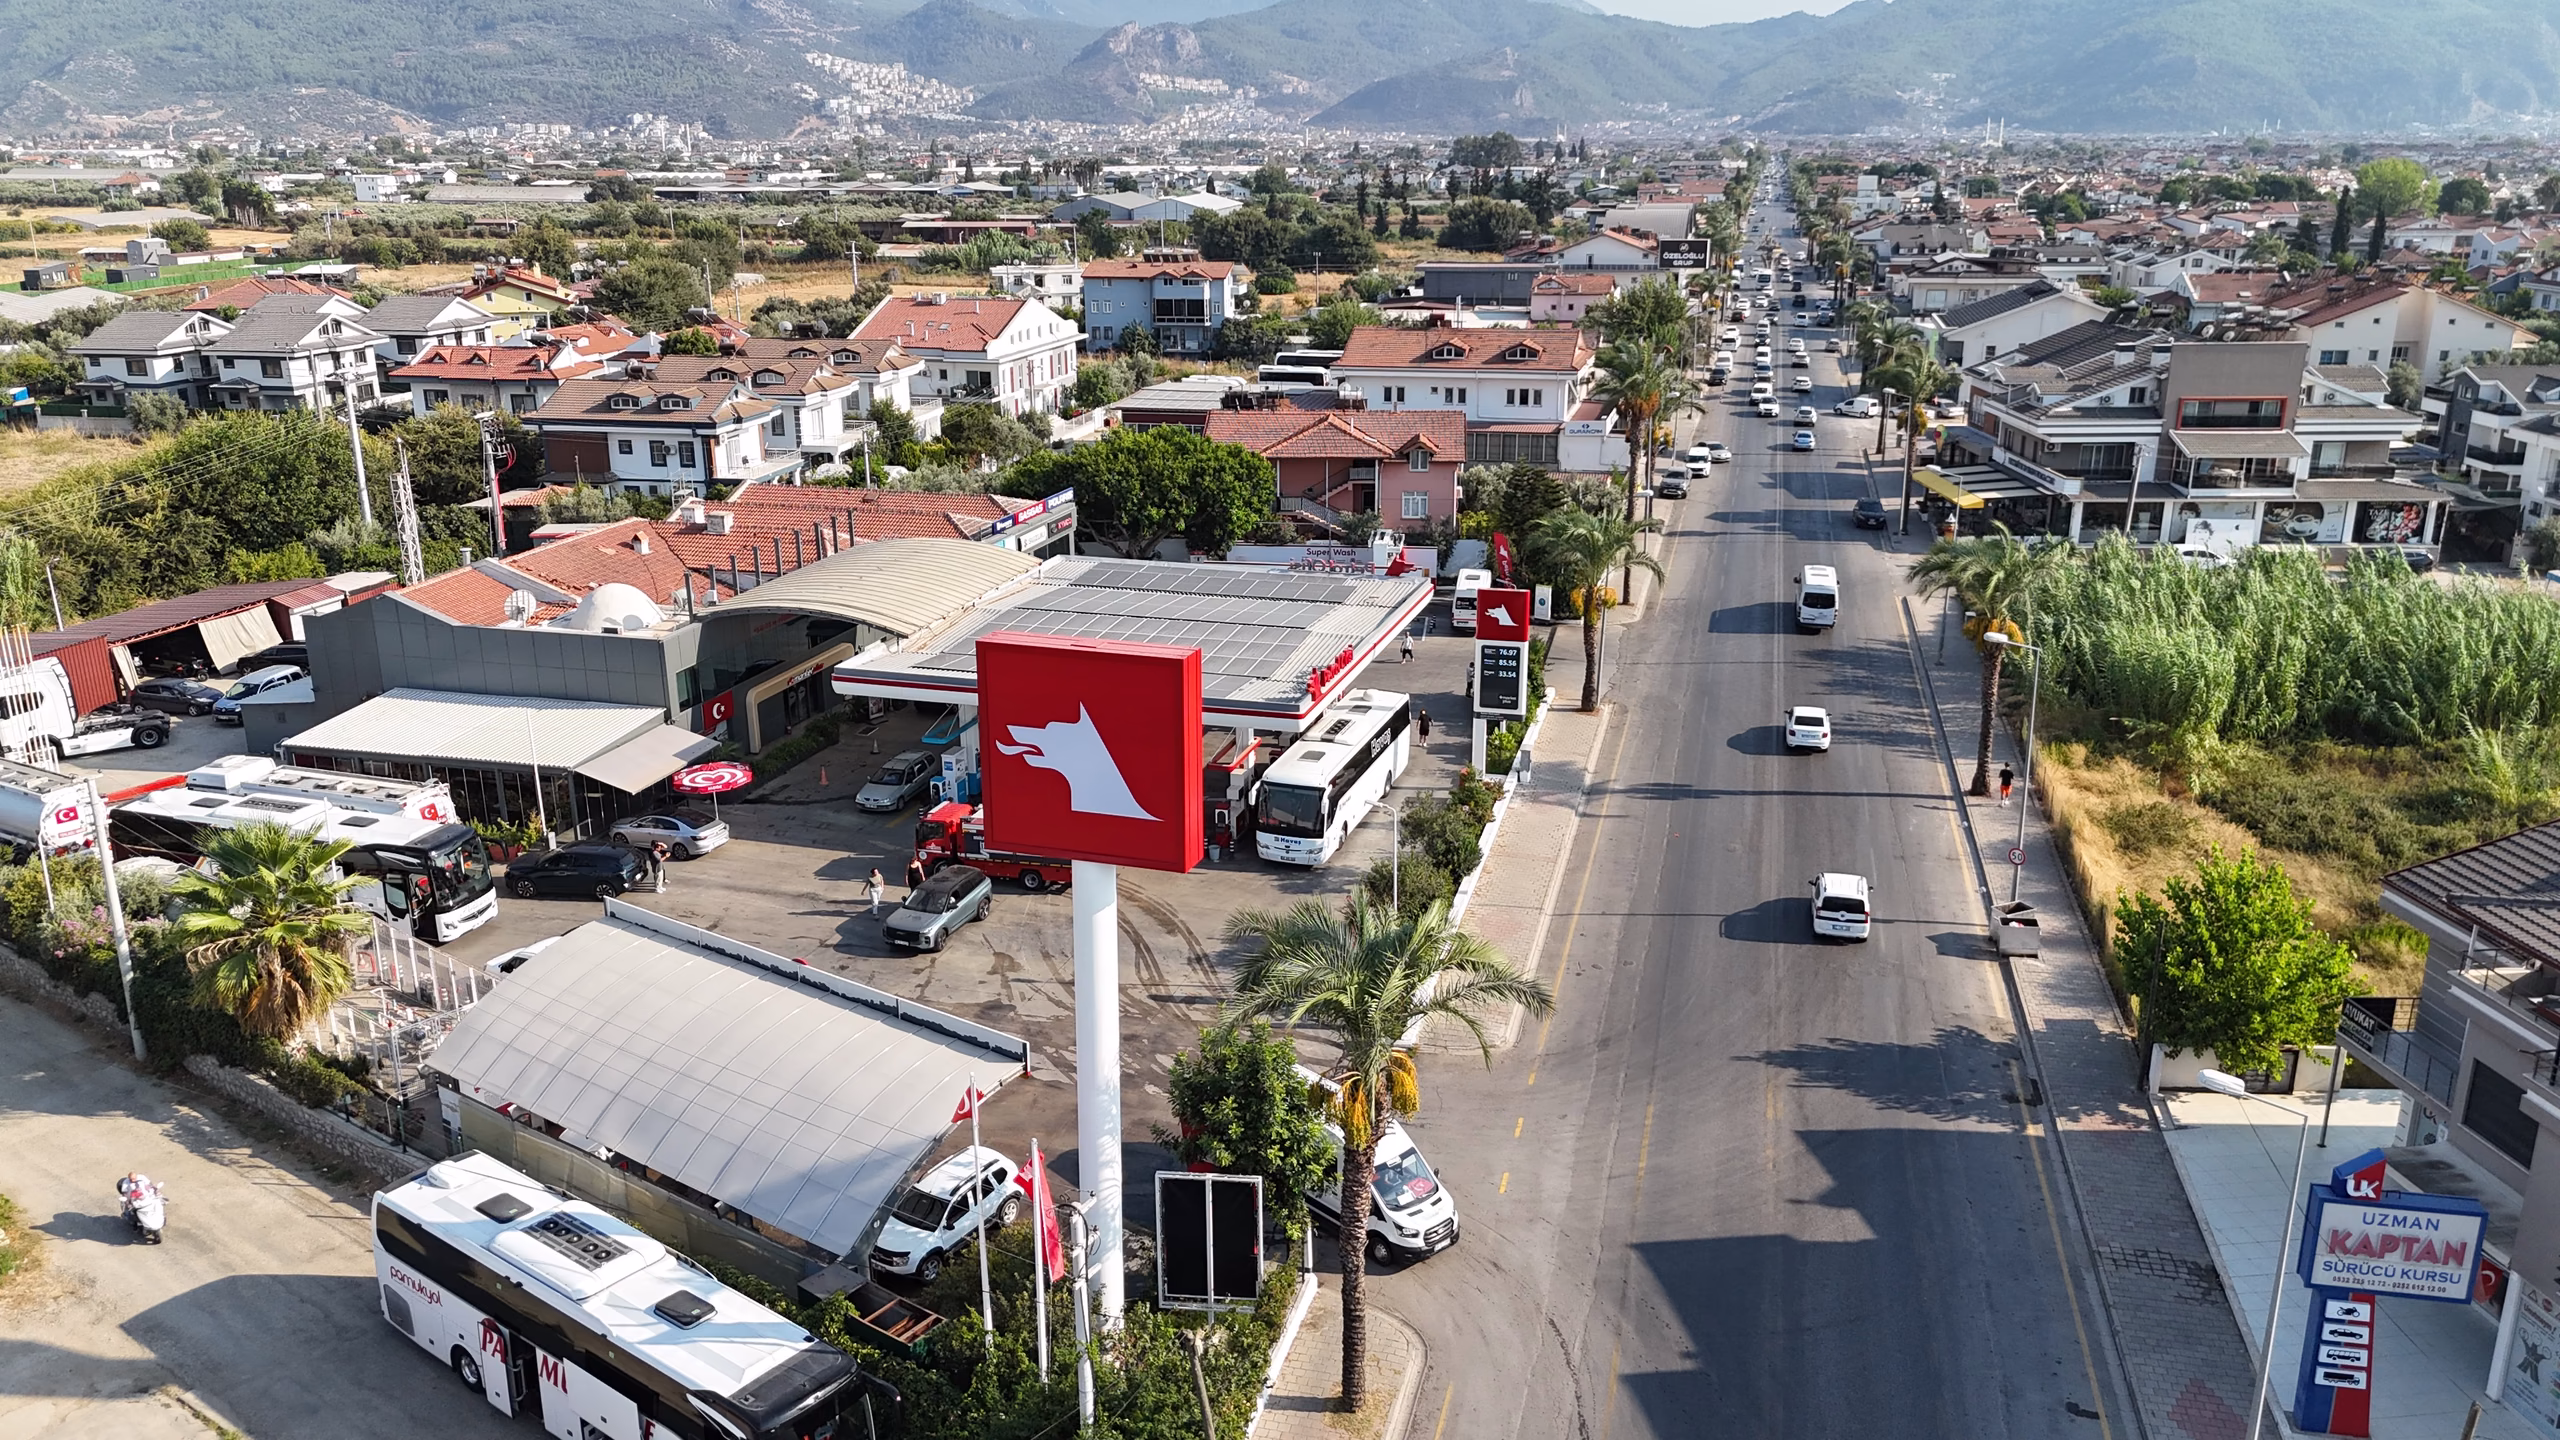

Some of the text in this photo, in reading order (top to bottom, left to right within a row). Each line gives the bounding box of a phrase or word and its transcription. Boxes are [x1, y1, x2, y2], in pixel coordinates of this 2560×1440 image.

[1662, 252, 1705, 260] ÖZELOĞLU
[1047, 490, 1074, 508] POLARIS
[1018, 503, 1044, 522] GASGAS
[1306, 549, 1330, 558] Super
[1499, 648, 1517, 656] 76.97
[1499, 659, 1517, 667] 85.56
[1498, 670, 1517, 678] 33.54
[2011, 851, 2023, 861] 50
[2344, 1003, 2375, 1031] AVUKAT
[2362, 1212, 2440, 1231] UZMAN
[2328, 1228, 2468, 1267] KAPTAN
[2322, 1259, 2462, 1284] SÜRÜCÜ KURSU
[390, 1265, 443, 1307] pamukyol
